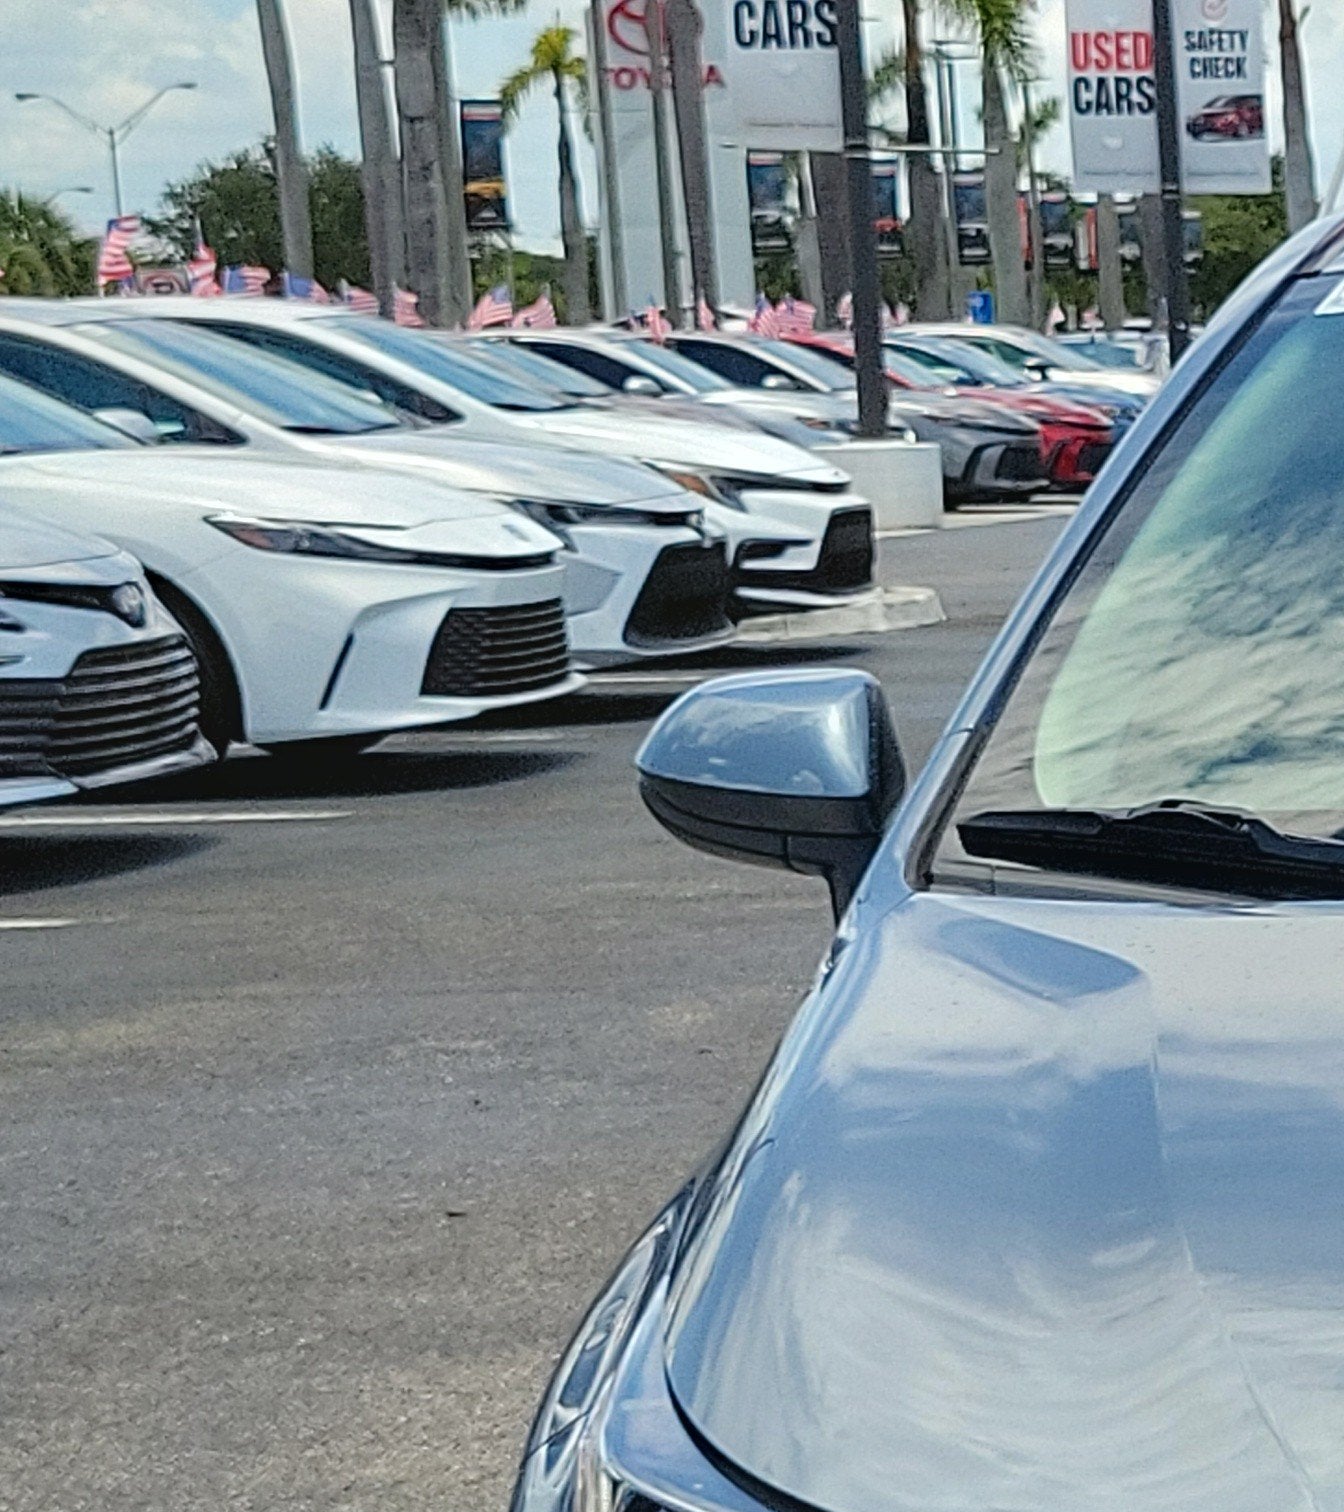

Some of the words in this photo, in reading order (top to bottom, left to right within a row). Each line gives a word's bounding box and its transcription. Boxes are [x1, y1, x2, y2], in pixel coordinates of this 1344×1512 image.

[734, 0, 838, 49] CARS
[1184, 29, 1248, 51] SAFETY
[1070, 32, 1154, 72] USED
[1189, 56, 1247, 79] CHECK
[1073, 76, 1155, 115] CARS
